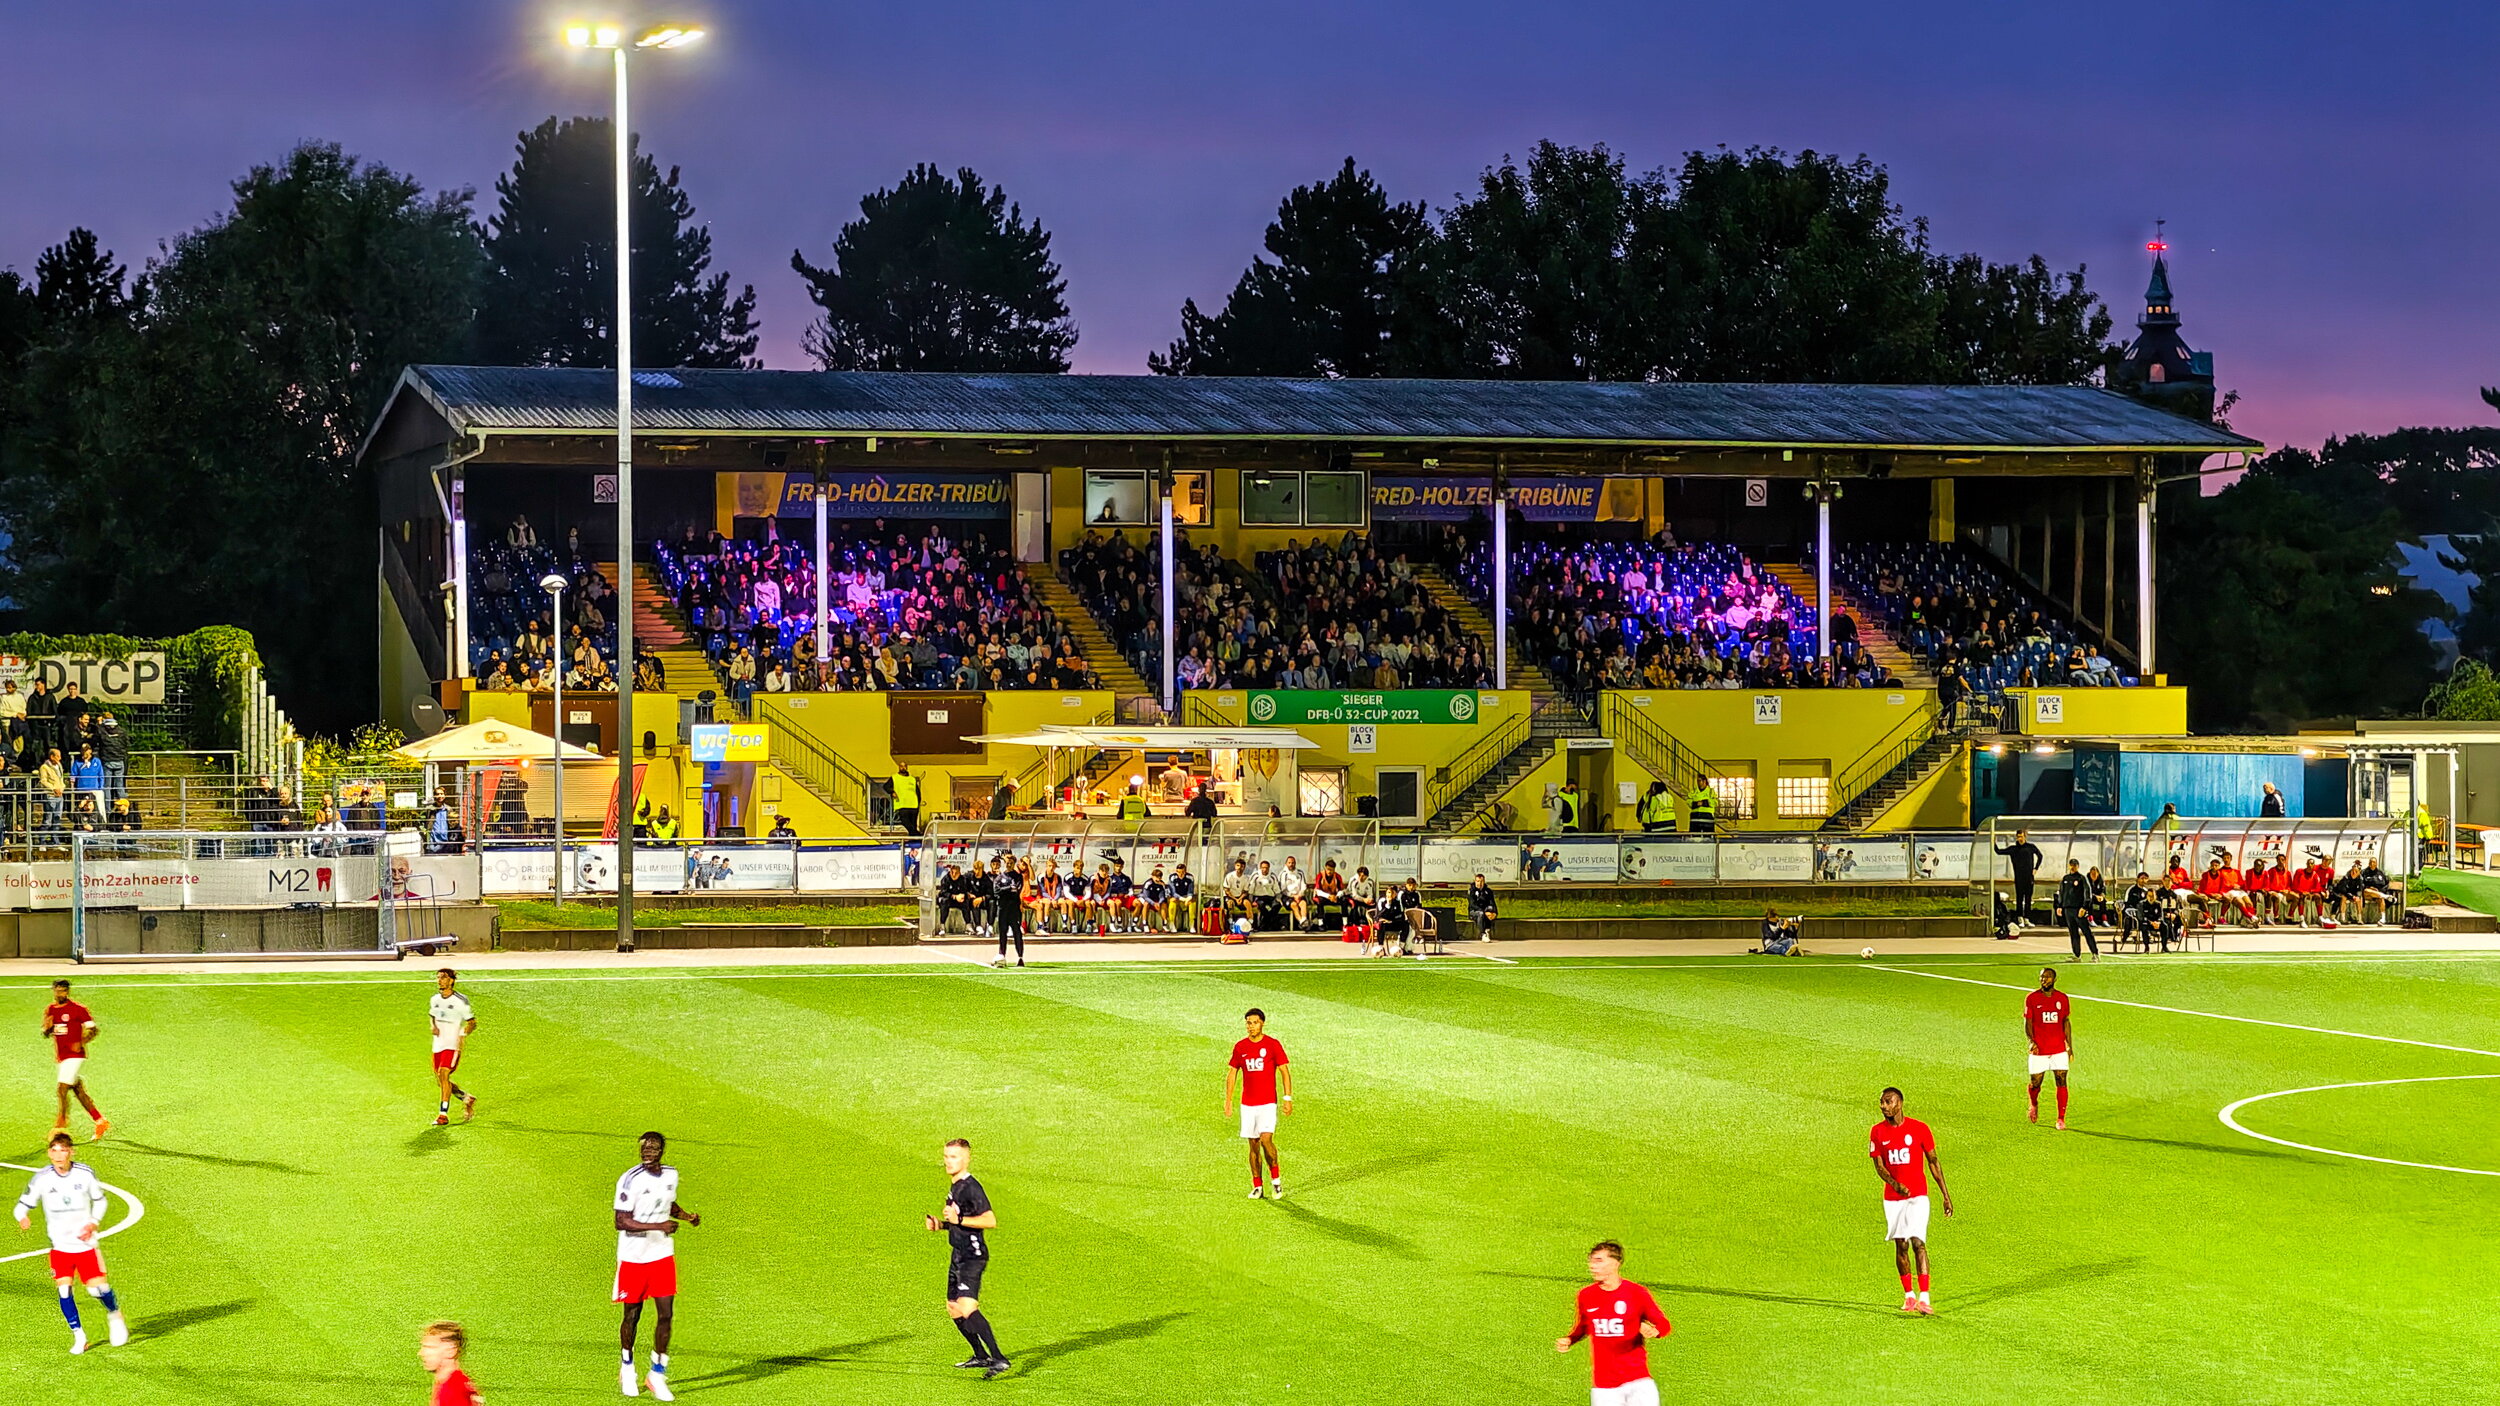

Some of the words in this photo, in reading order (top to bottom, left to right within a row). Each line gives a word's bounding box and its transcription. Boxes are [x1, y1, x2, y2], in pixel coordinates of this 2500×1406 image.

[39, 659, 160, 695] DTCP
[1342, 695, 1383, 705] SIEGER
[1307, 707, 1342, 720] DFB-Ü
[1346, 709, 1388, 720] 32-CUP
[1392, 709, 1419, 720] 2022
[1759, 705, 1767, 716] A
[1769, 705, 1777, 716] 4
[2041, 704, 2049, 714] A
[2051, 704, 2058, 714] 5
[1350, 726, 1374, 734] BLOCK
[699, 734, 762, 749] VICTOR
[1354, 734, 1362, 744] A
[1364, 734, 1372, 744] 3
[739, 863, 762, 872] UNSER
[864, 864, 898, 872] HEIDRICH
[5, 874, 51, 888] follow
[57, 878, 73, 888] us
[269, 869, 310, 893] M2
[2042, 1011, 2058, 1022] HG
[1245, 1057, 1264, 1070] HG
[1888, 1147, 1911, 1163] HG
[1592, 1318, 1624, 1334] HG
